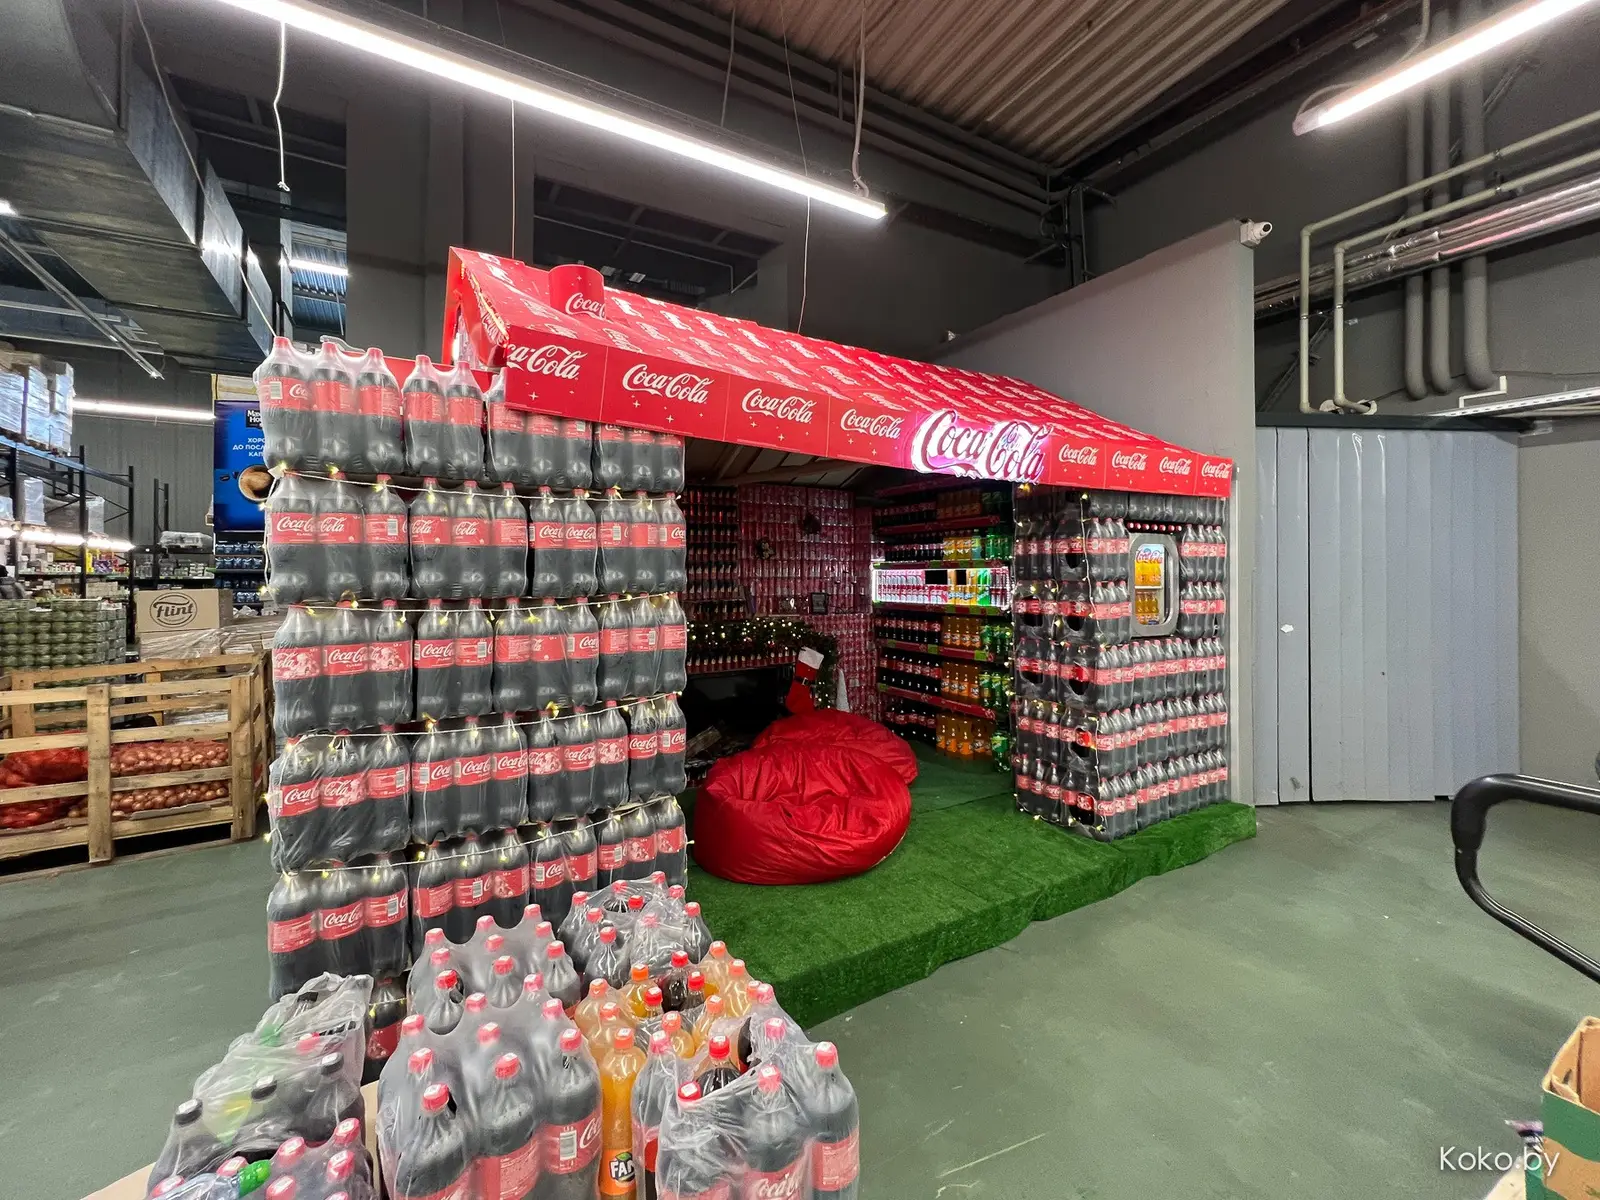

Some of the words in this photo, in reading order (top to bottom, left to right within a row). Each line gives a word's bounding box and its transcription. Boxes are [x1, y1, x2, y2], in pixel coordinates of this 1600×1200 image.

[622, 363, 714, 404] Coca-Cola
[742, 388, 817, 423] Coca-Cola
[841, 408, 905, 438] Coca-Cola
[918, 408, 1052, 482] Coca-Cola
[1059, 443, 1099, 466] Coca-Cola
[1112, 450, 1148, 471] Coca-Cola
[1159, 456, 1193, 475] Coca-Cola
[1201, 461, 1232, 479] Coca-Cola
[152, 600, 194, 618] Flint
